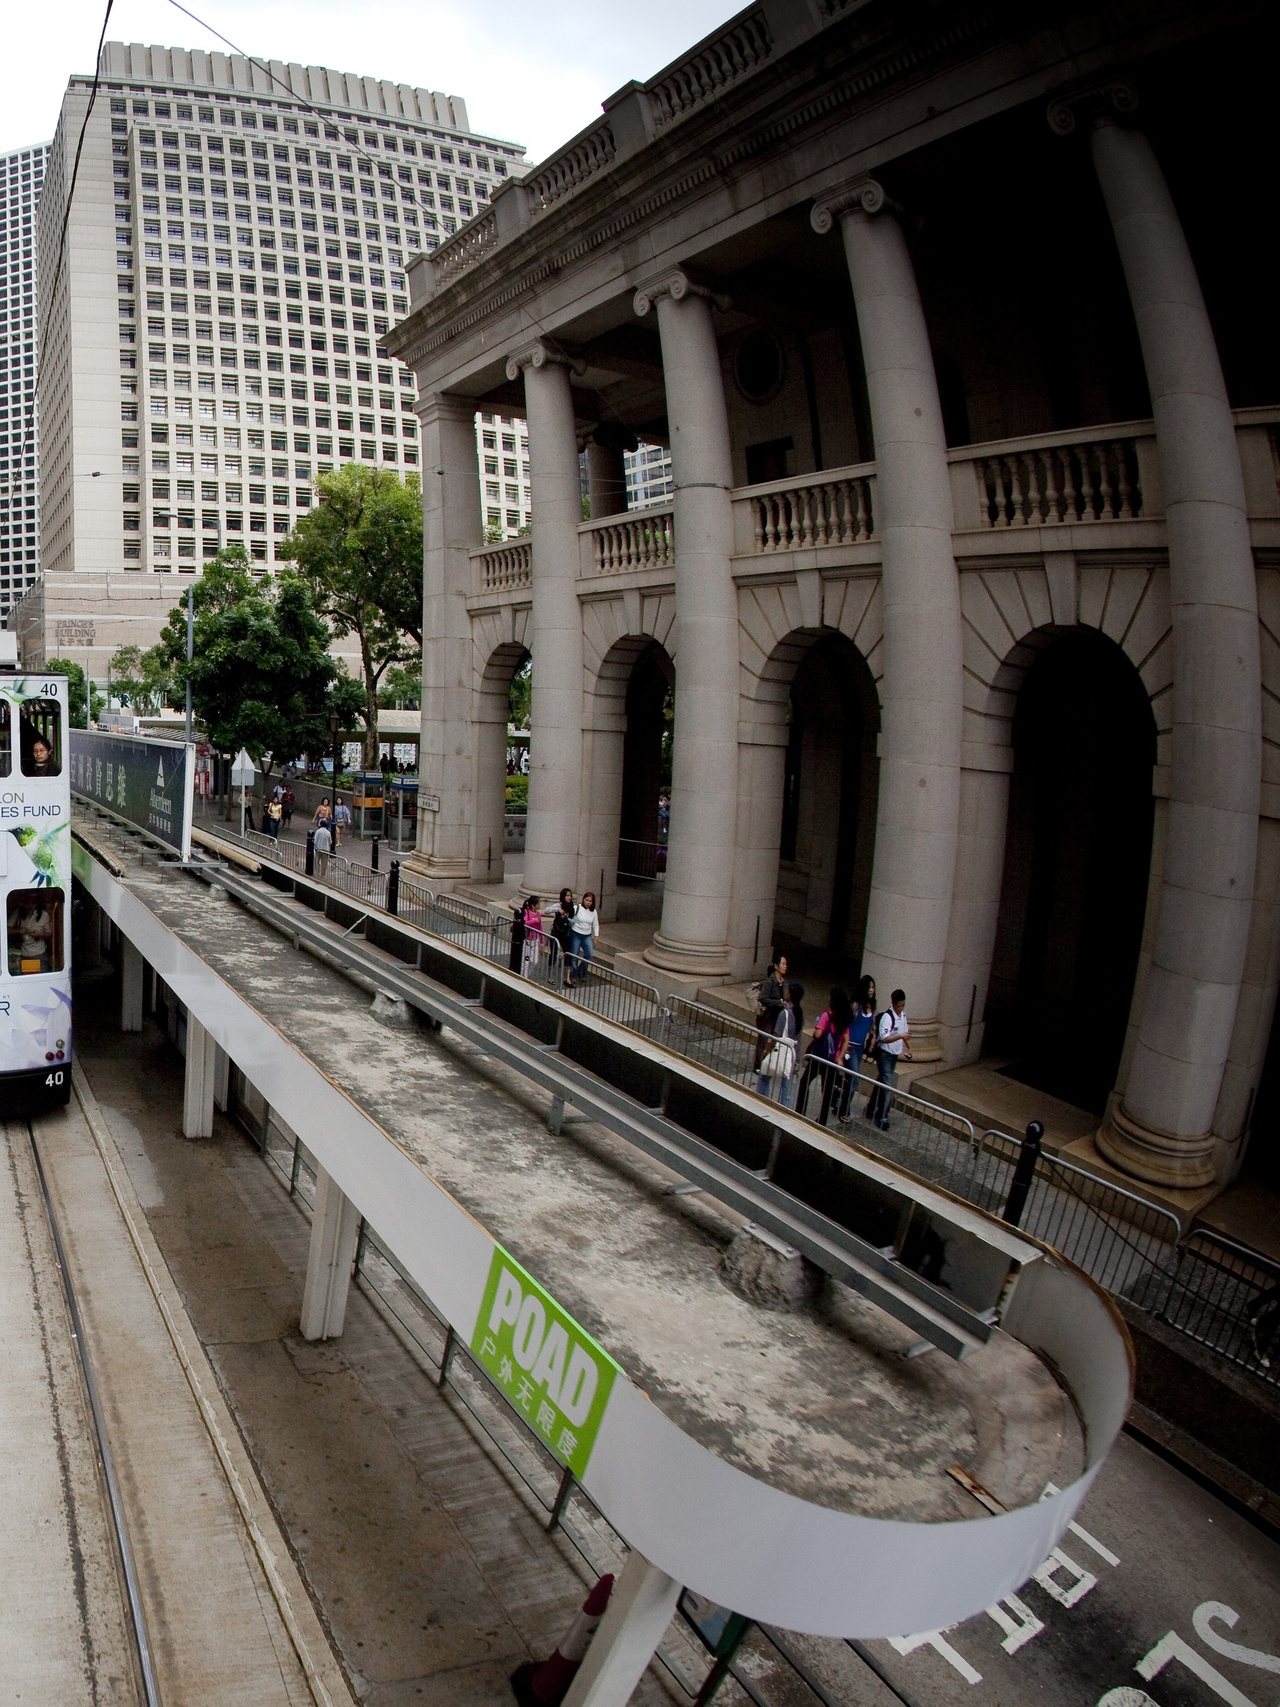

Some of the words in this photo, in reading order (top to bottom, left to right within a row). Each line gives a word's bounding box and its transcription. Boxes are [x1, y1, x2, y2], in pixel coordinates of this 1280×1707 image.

[57, 619, 94, 628] PRINCE'S
[55, 629, 96, 638] BUILDING
[40, 683, 58, 696] 40
[23, 805, 61, 817] FUND
[45, 1071, 64, 1087] 40
[488, 1266, 598, 1428] POAD
